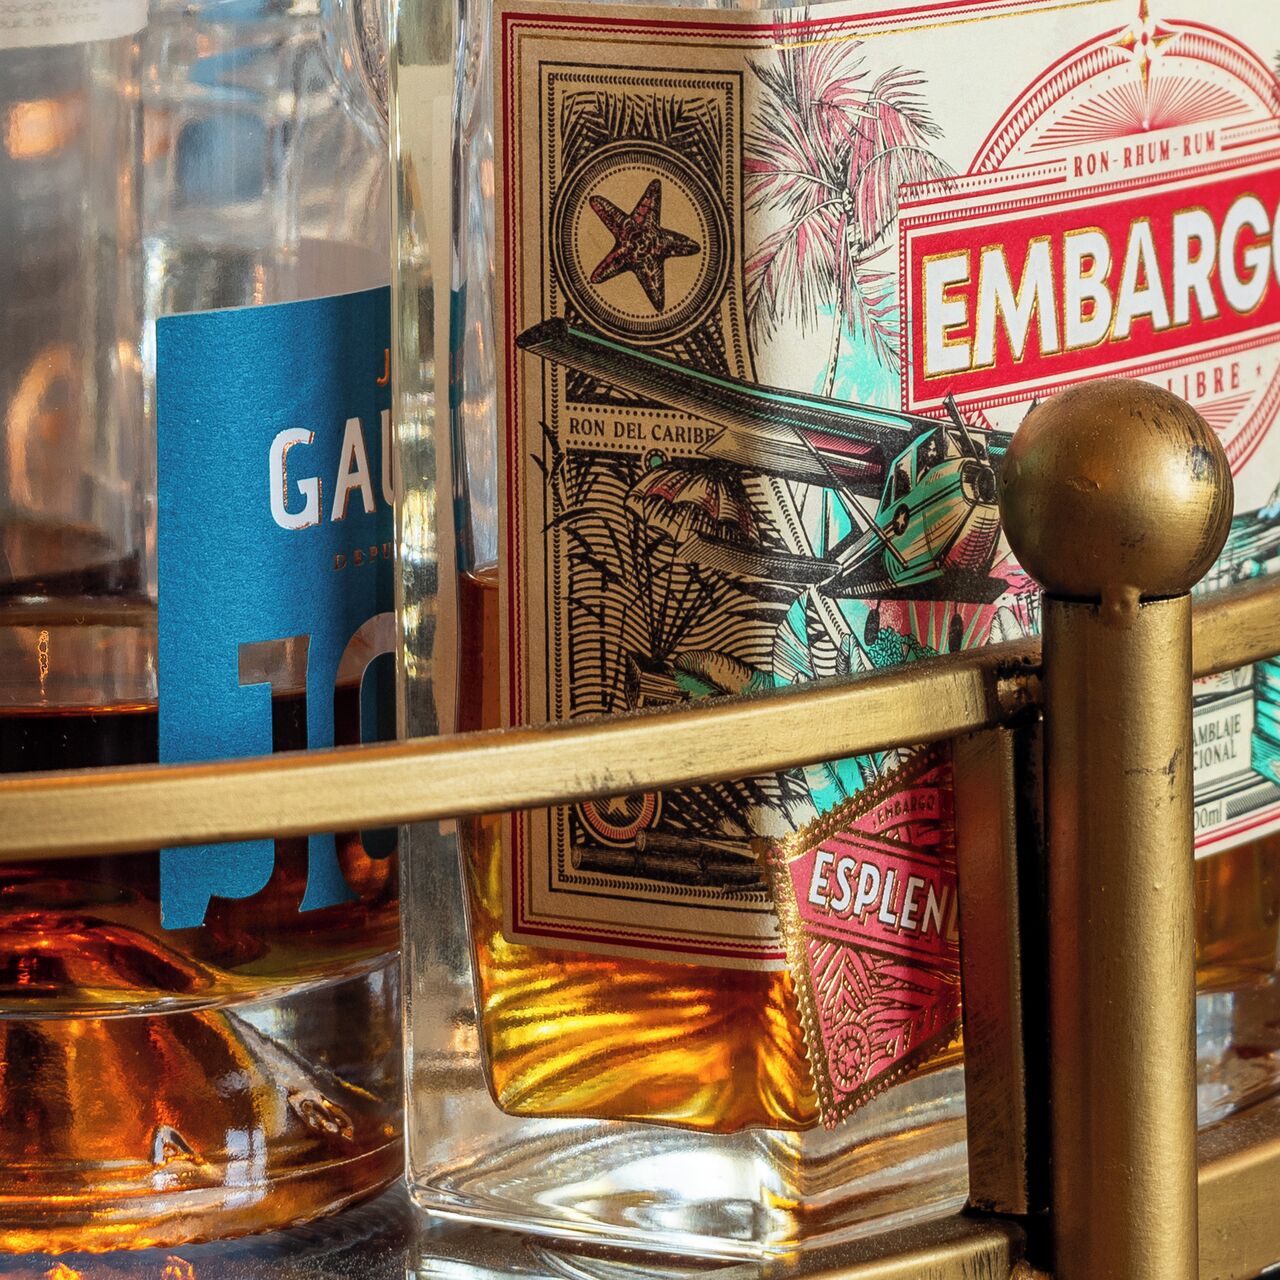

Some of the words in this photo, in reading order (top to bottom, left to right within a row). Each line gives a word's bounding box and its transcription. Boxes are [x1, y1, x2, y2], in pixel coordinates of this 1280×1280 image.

[569, 417, 605, 437] RON
[614, 421, 646, 440] DEL
[651, 424, 716, 445] CARIBE
